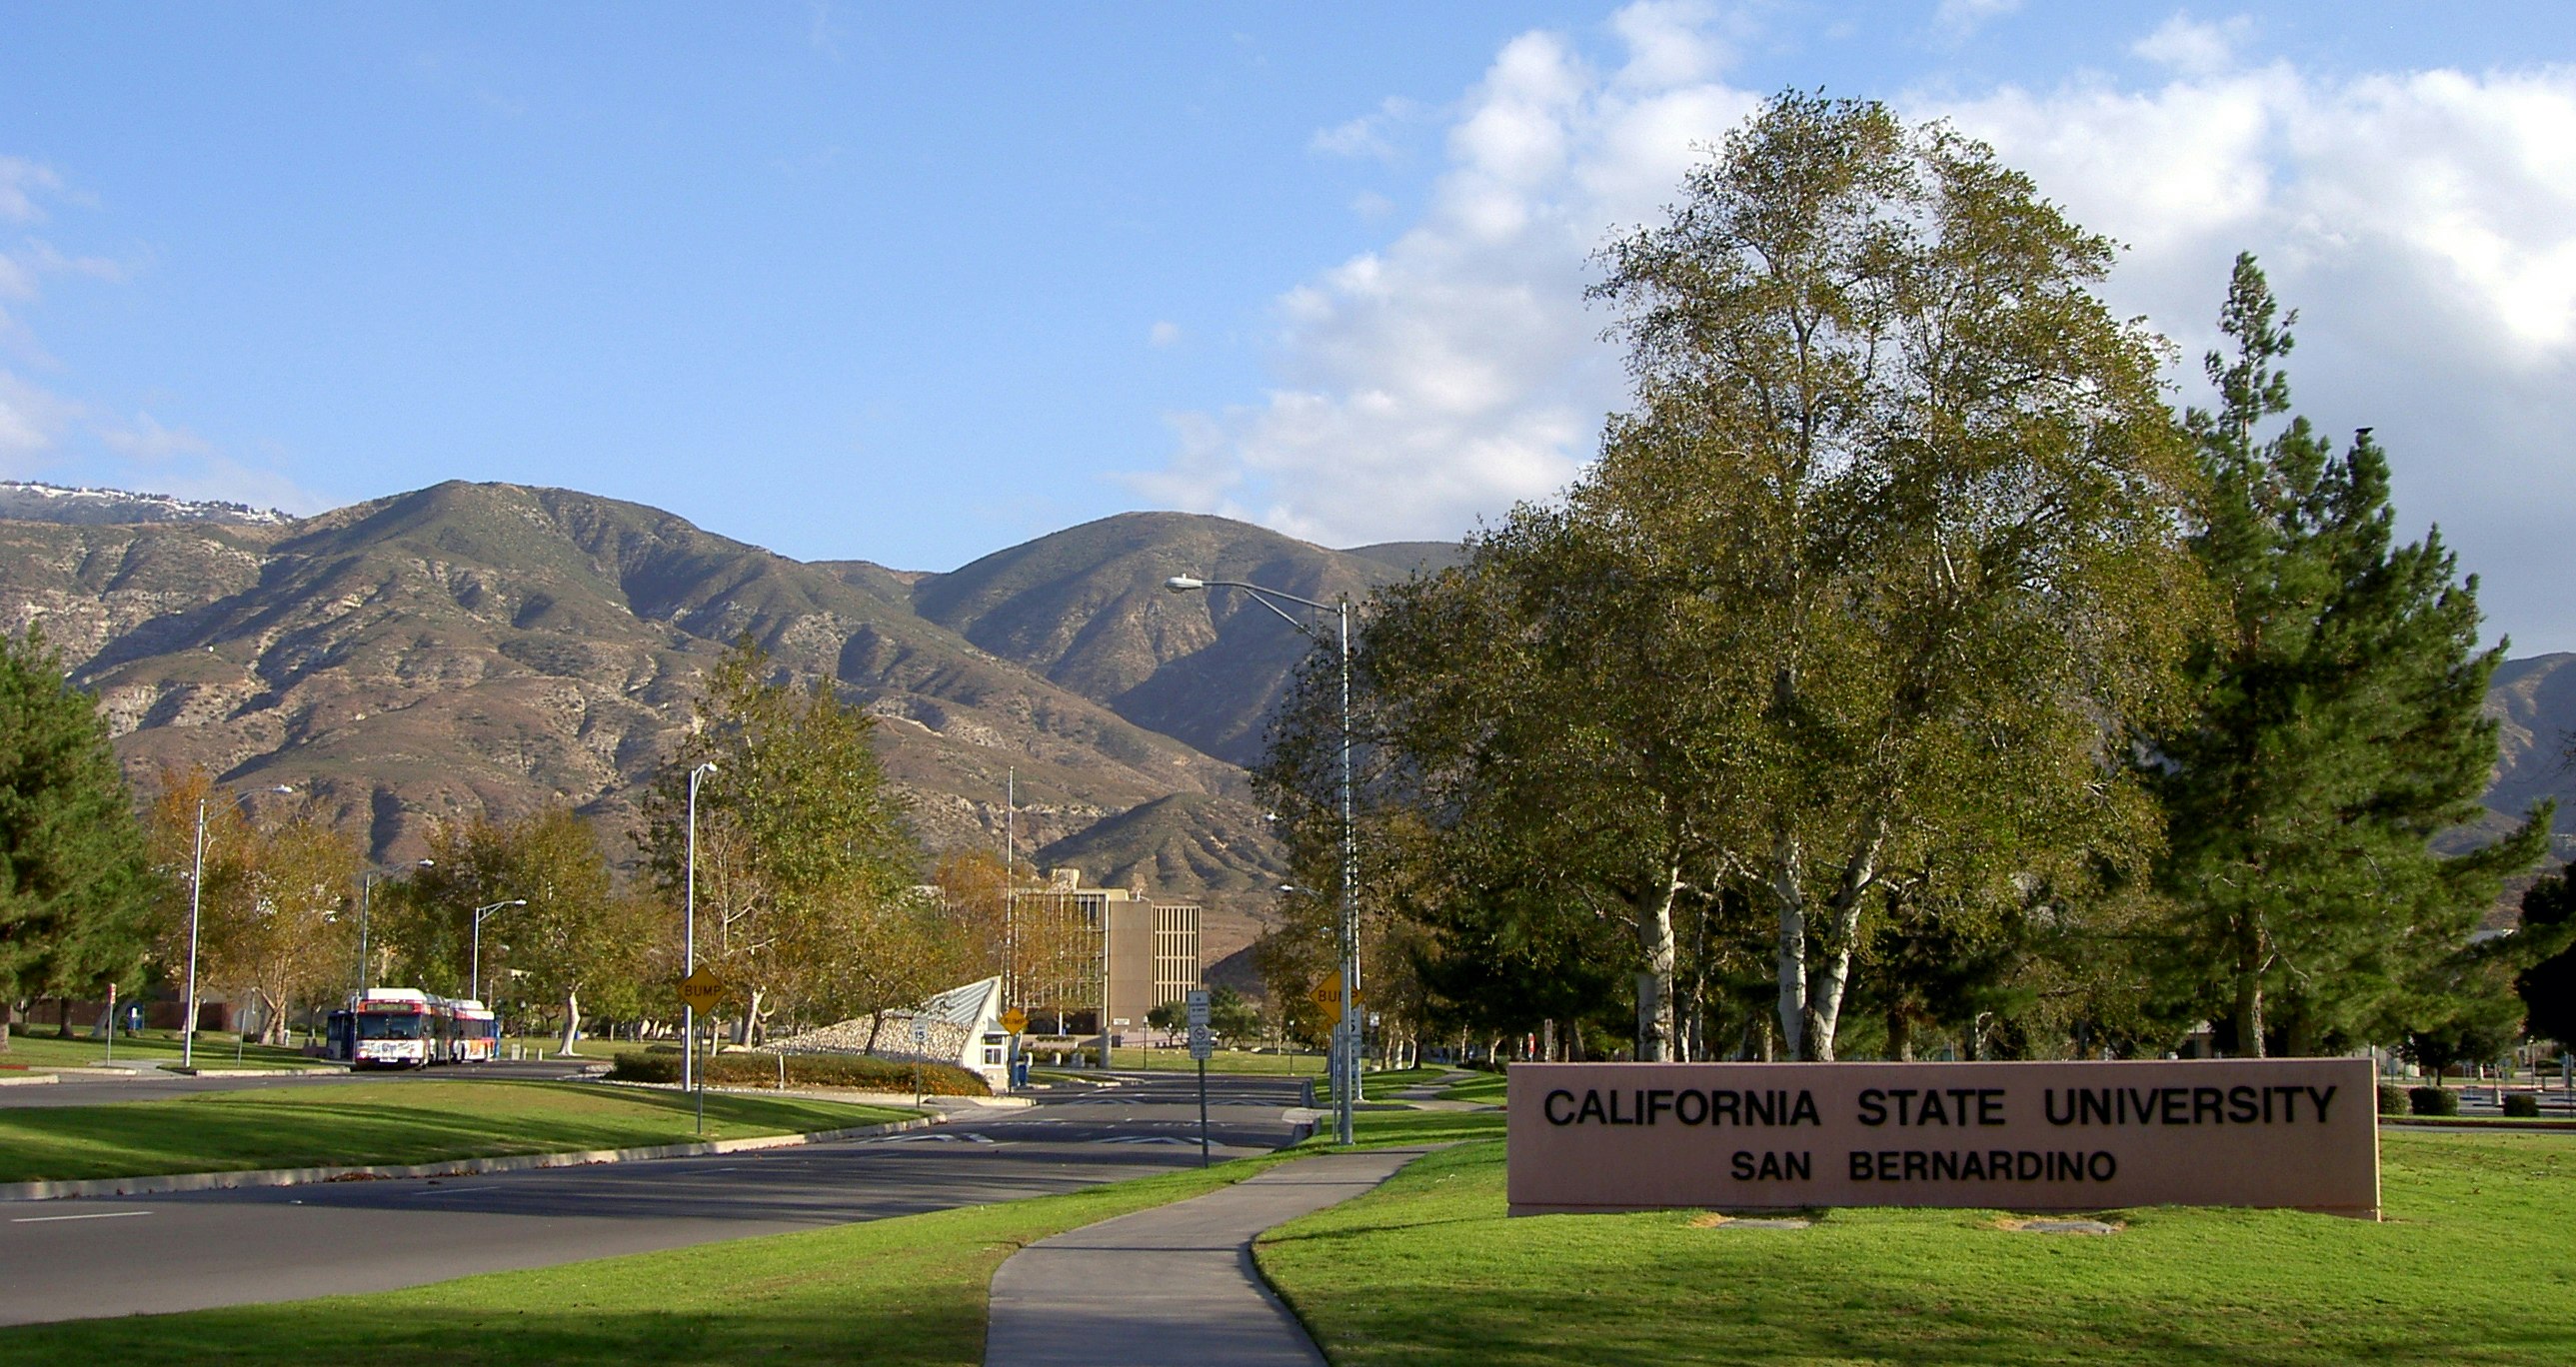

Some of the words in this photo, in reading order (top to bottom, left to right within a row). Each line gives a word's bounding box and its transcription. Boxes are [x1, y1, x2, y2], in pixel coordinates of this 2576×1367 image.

[685, 985, 721, 997] BUMP
[1318, 989, 1358, 1002] BUP
[915, 1031, 925, 1040] 15
[1543, 1088, 1822, 1127] CALIFORNIA
[1857, 1087, 2006, 1127] STATE
[2044, 1085, 2338, 1127] UNIVERSITY
[1730, 1150, 1811, 1182] SAN
[1848, 1150, 2118, 1183] BERNARDINO
